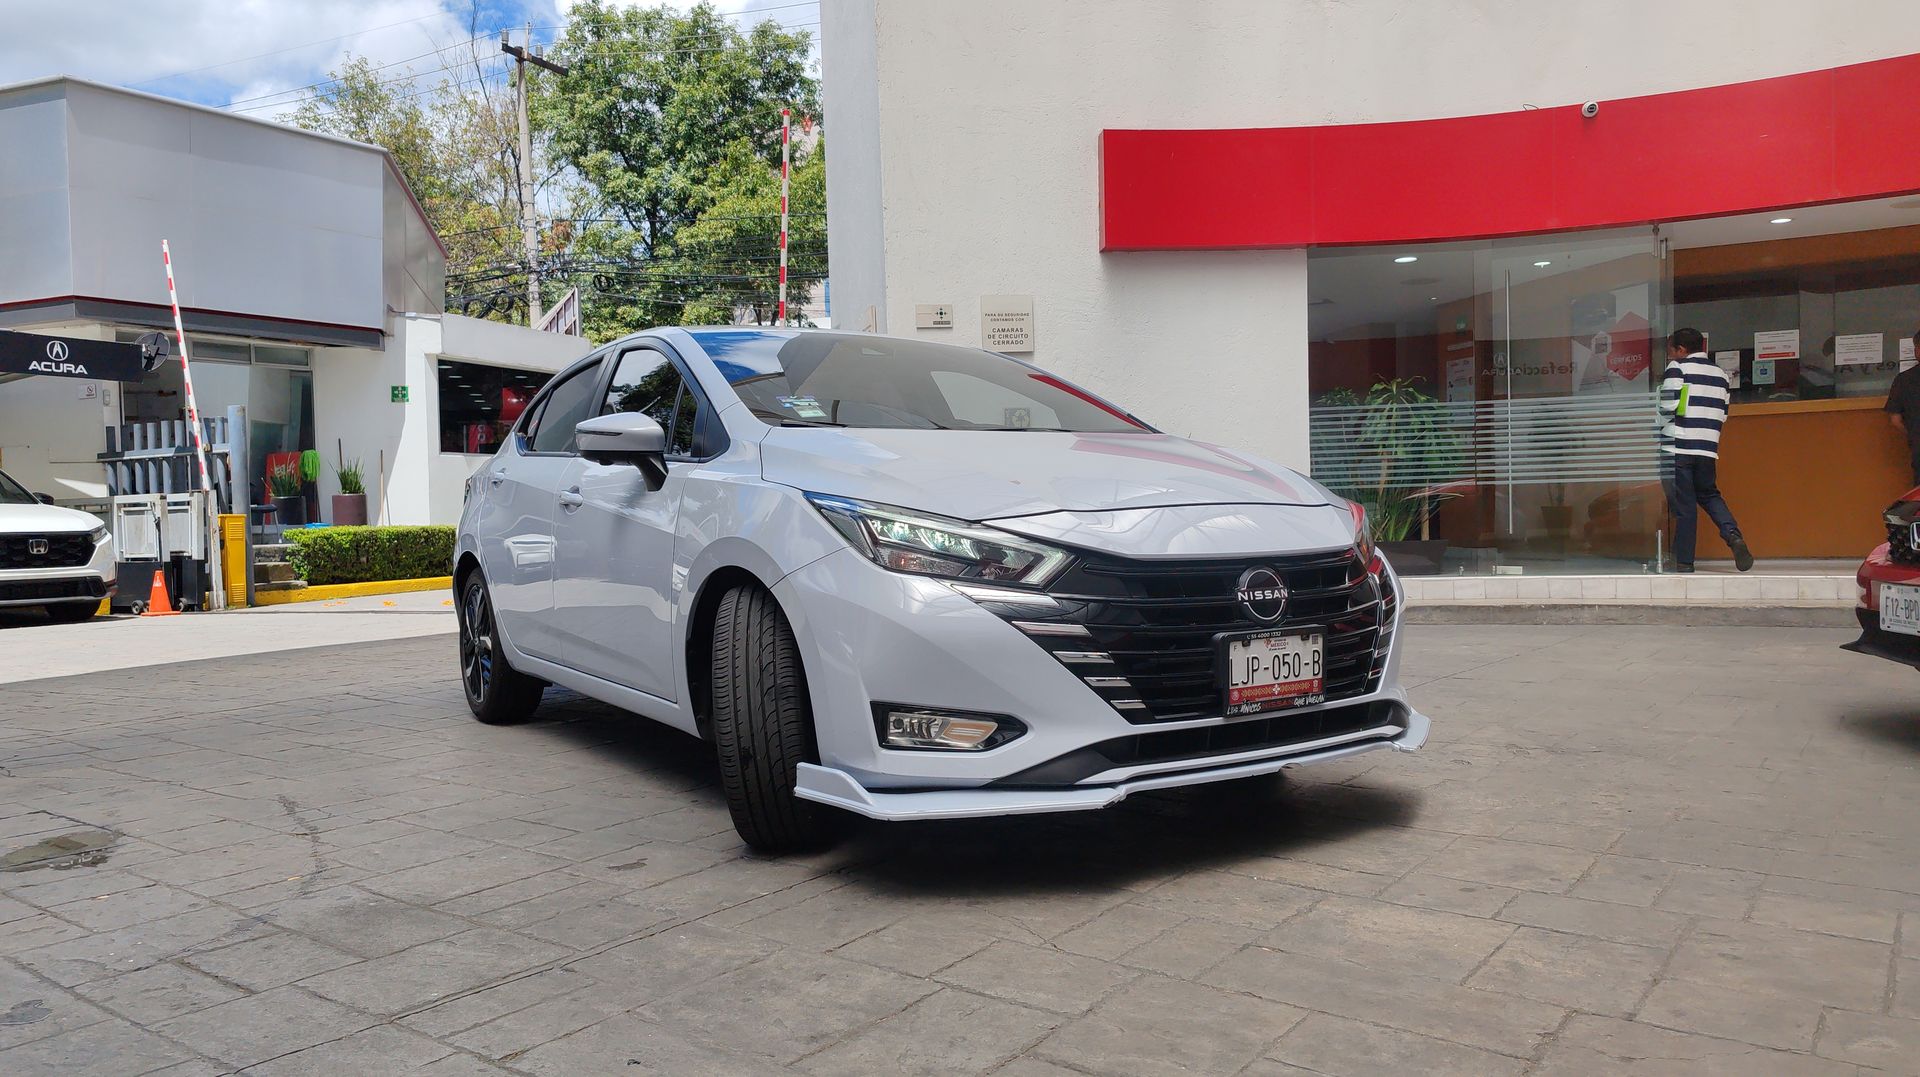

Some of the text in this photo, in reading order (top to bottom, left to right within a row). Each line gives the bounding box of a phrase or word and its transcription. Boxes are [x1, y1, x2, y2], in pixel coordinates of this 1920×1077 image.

[28, 361, 88, 374] ACURA
[1237, 588, 1288, 601] NISSAN
[1230, 649, 1320, 686] LJP-050-B
